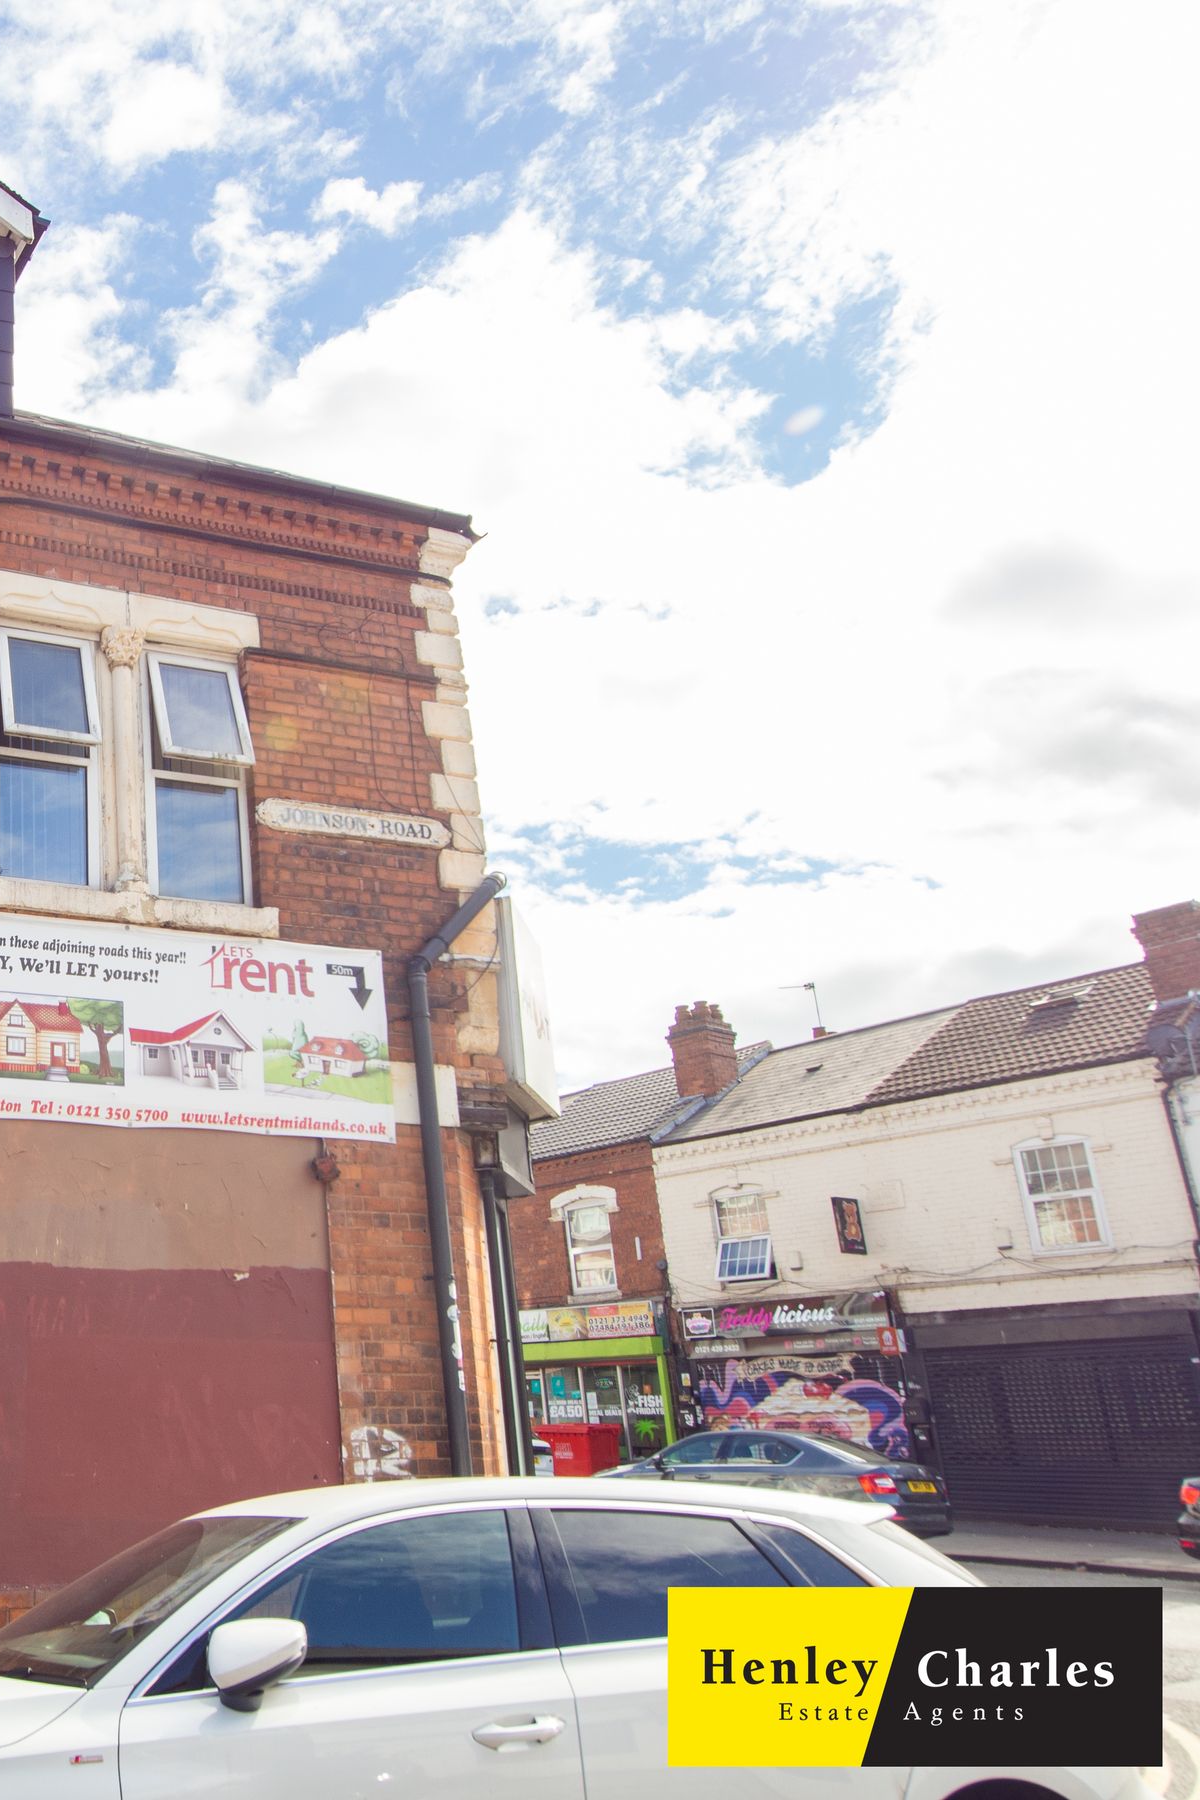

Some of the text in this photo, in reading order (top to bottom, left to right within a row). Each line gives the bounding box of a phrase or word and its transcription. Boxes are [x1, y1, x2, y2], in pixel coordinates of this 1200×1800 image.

[281, 807, 432, 839] JOHNSON ROAD
[9, 935, 39, 950] these
[42, 939, 96, 958] adjoining
[99, 945, 129, 958] roads
[132, 947, 152, 961] this
[155, 951, 187, 965] year!!
[223, 945, 254, 958] LETS
[19, 957, 61, 974] We'll
[66, 961, 99, 977] LET
[102, 968, 159, 984] yours!!
[331, 965, 353, 976] 50m
[223, 957, 316, 998] rent
[31, 1099, 54, 1114] Tel
[66, 1104, 100, 1118] 0121
[105, 1107, 131, 1121] 350
[135, 1109, 169, 1123] 5700
[181, 1111, 387, 1135] www.letsrentmidlands.co.uk
[588, 1313, 649, 1325] 0121 373 4949
[695, 1346, 710, 1354] 0121
[638, 1395, 663, 1408] FISH
[550, 1405, 584, 1418] £4.50
